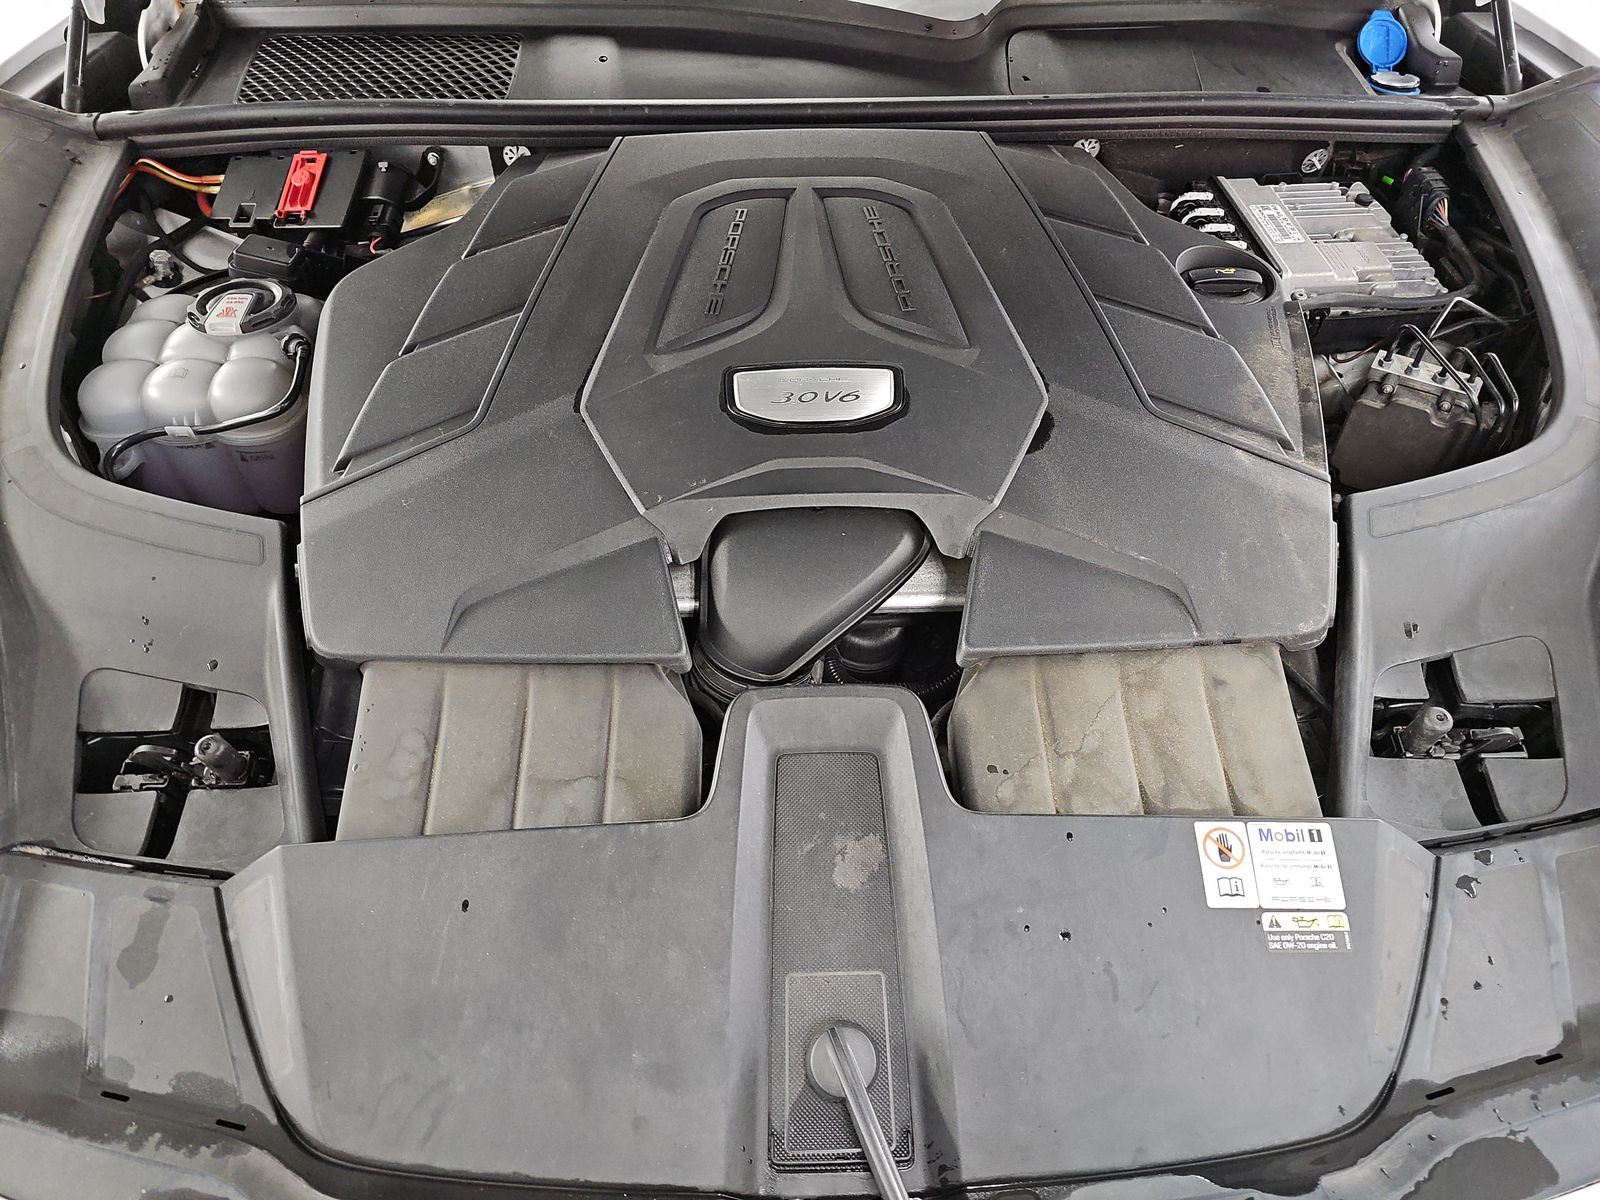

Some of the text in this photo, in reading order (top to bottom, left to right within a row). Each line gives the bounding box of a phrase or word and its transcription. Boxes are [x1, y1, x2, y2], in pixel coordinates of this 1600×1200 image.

[704, 208, 748, 316] PORSCHE
[863, 206, 917, 312] PORSCHE
[824, 389, 861, 403] V6
[1258, 828, 1323, 843] Mobil 1
[1267, 933, 1280, 941] Use
[1281, 933, 1294, 942] only
[1294, 933, 1320, 941] Porsche
[1320, 933, 1335, 941] C20
[1306, 942, 1328, 951] engine
